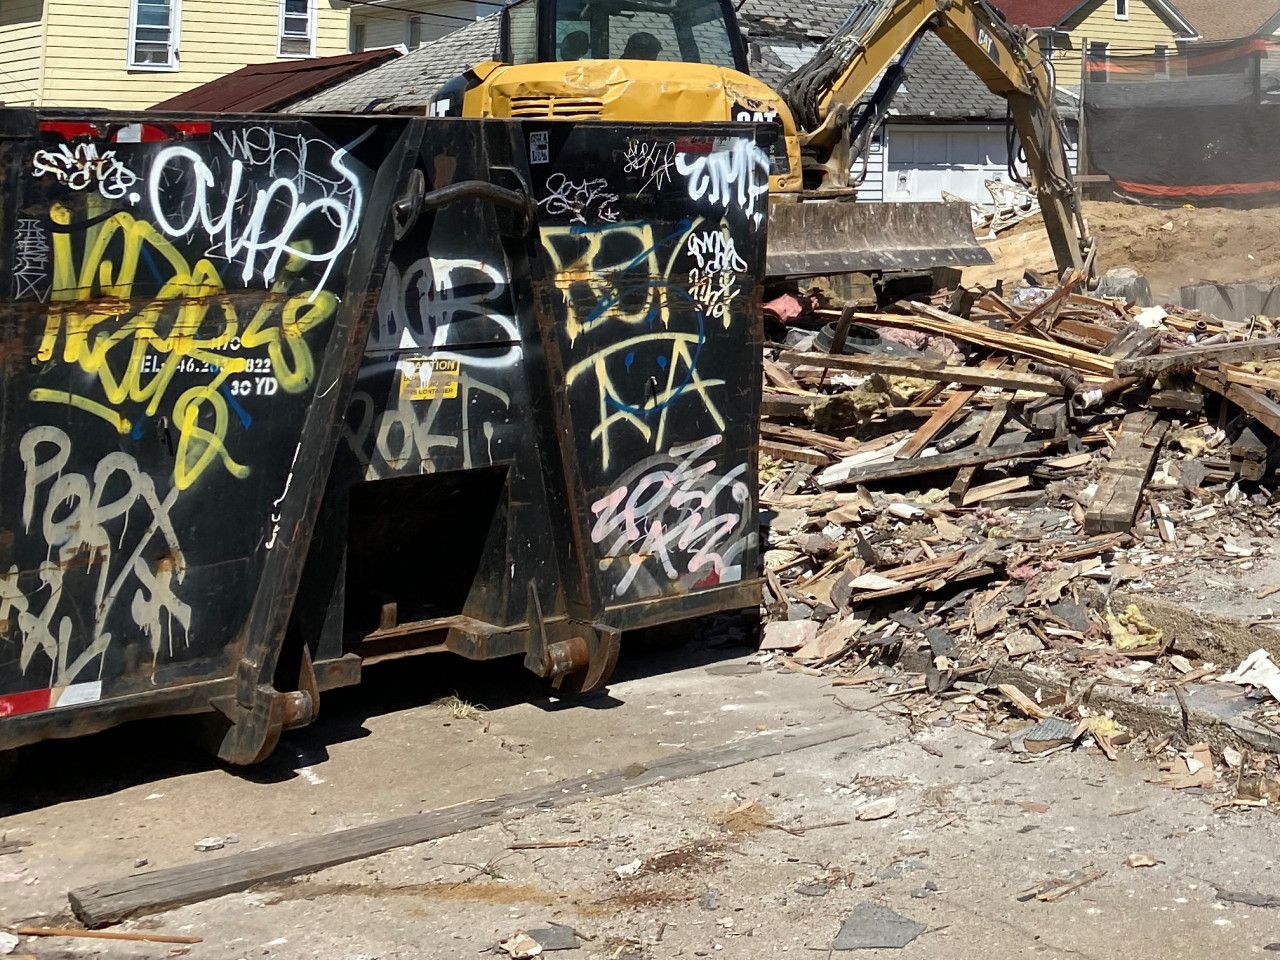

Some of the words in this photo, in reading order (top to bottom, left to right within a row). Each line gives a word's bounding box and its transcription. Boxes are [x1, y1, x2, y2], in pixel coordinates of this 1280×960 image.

[978, 28, 993, 54] CAT
[230, 380, 252, 396] 30
[255, 376, 279, 396] YD
